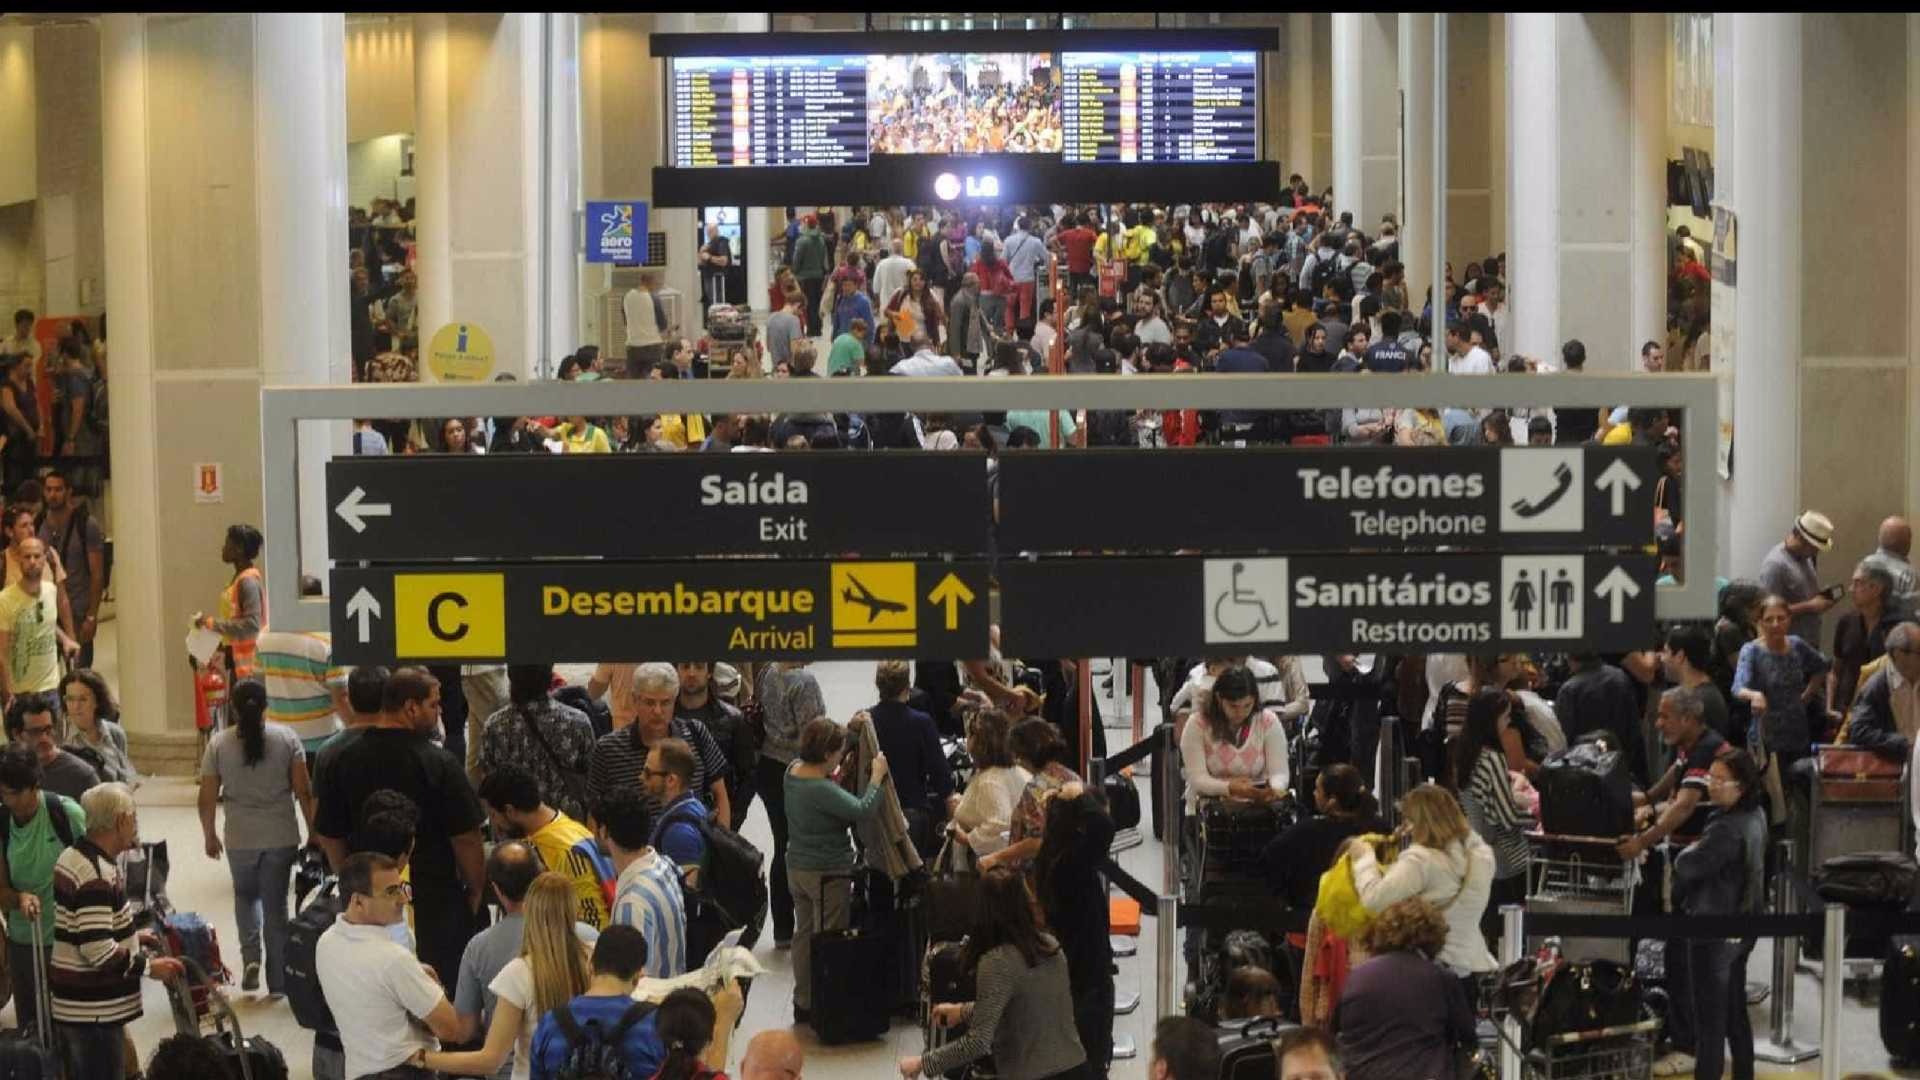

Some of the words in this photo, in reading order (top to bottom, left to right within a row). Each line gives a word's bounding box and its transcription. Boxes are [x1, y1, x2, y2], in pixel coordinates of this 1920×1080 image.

[966, 176, 999, 197] LG
[601, 236, 633, 247] aero
[700, 472, 809, 505] Saída
[1297, 466, 1484, 500] Telefones
[759, 517, 808, 542] Exit
[1351, 509, 1486, 539] Telephone
[542, 583, 814, 619] Desembarque
[1295, 572, 1492, 608] Sanitários
[426, 591, 470, 643] C
[1351, 618, 1491, 644] Restrooms
[729, 624, 815, 651] Arrival
